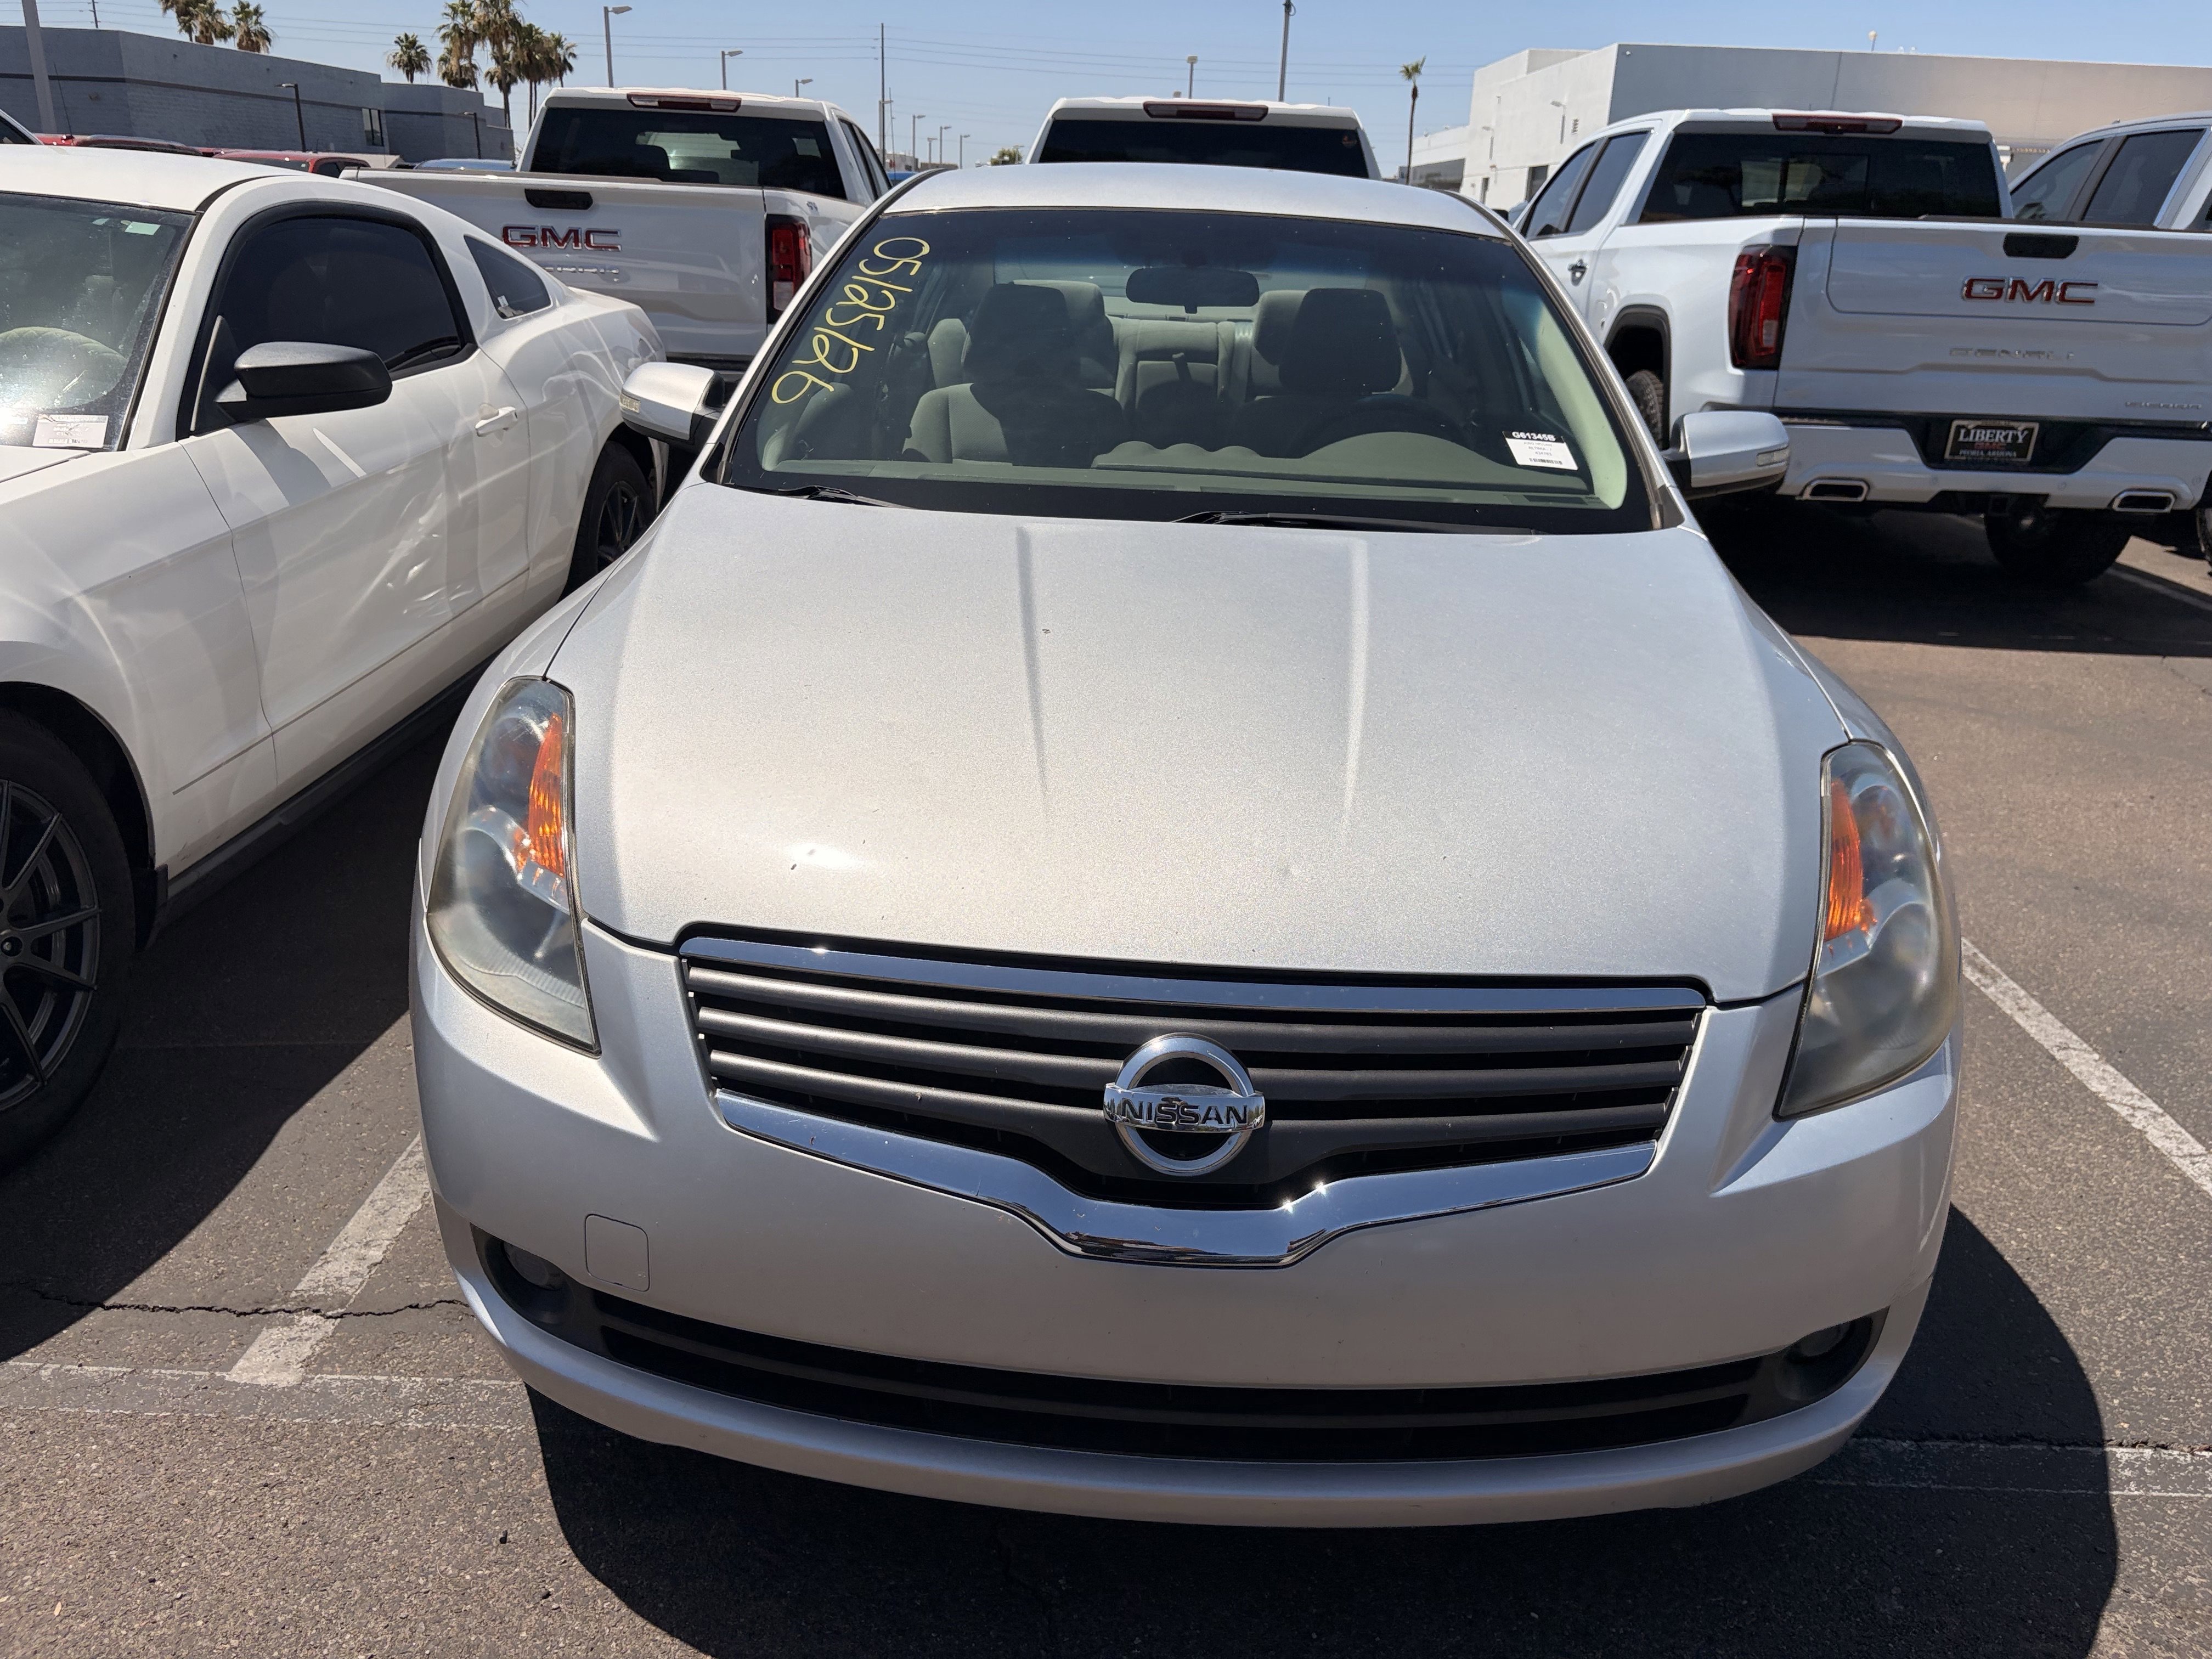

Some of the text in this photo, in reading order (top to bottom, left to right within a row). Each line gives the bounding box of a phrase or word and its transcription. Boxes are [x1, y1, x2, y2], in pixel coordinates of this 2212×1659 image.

[501, 224, 622, 251] GMC
[1961, 275, 2099, 306] GMC
[1957, 428, 2028, 443] LIBERTY
[1121, 1097, 1248, 1125] NISSAN
